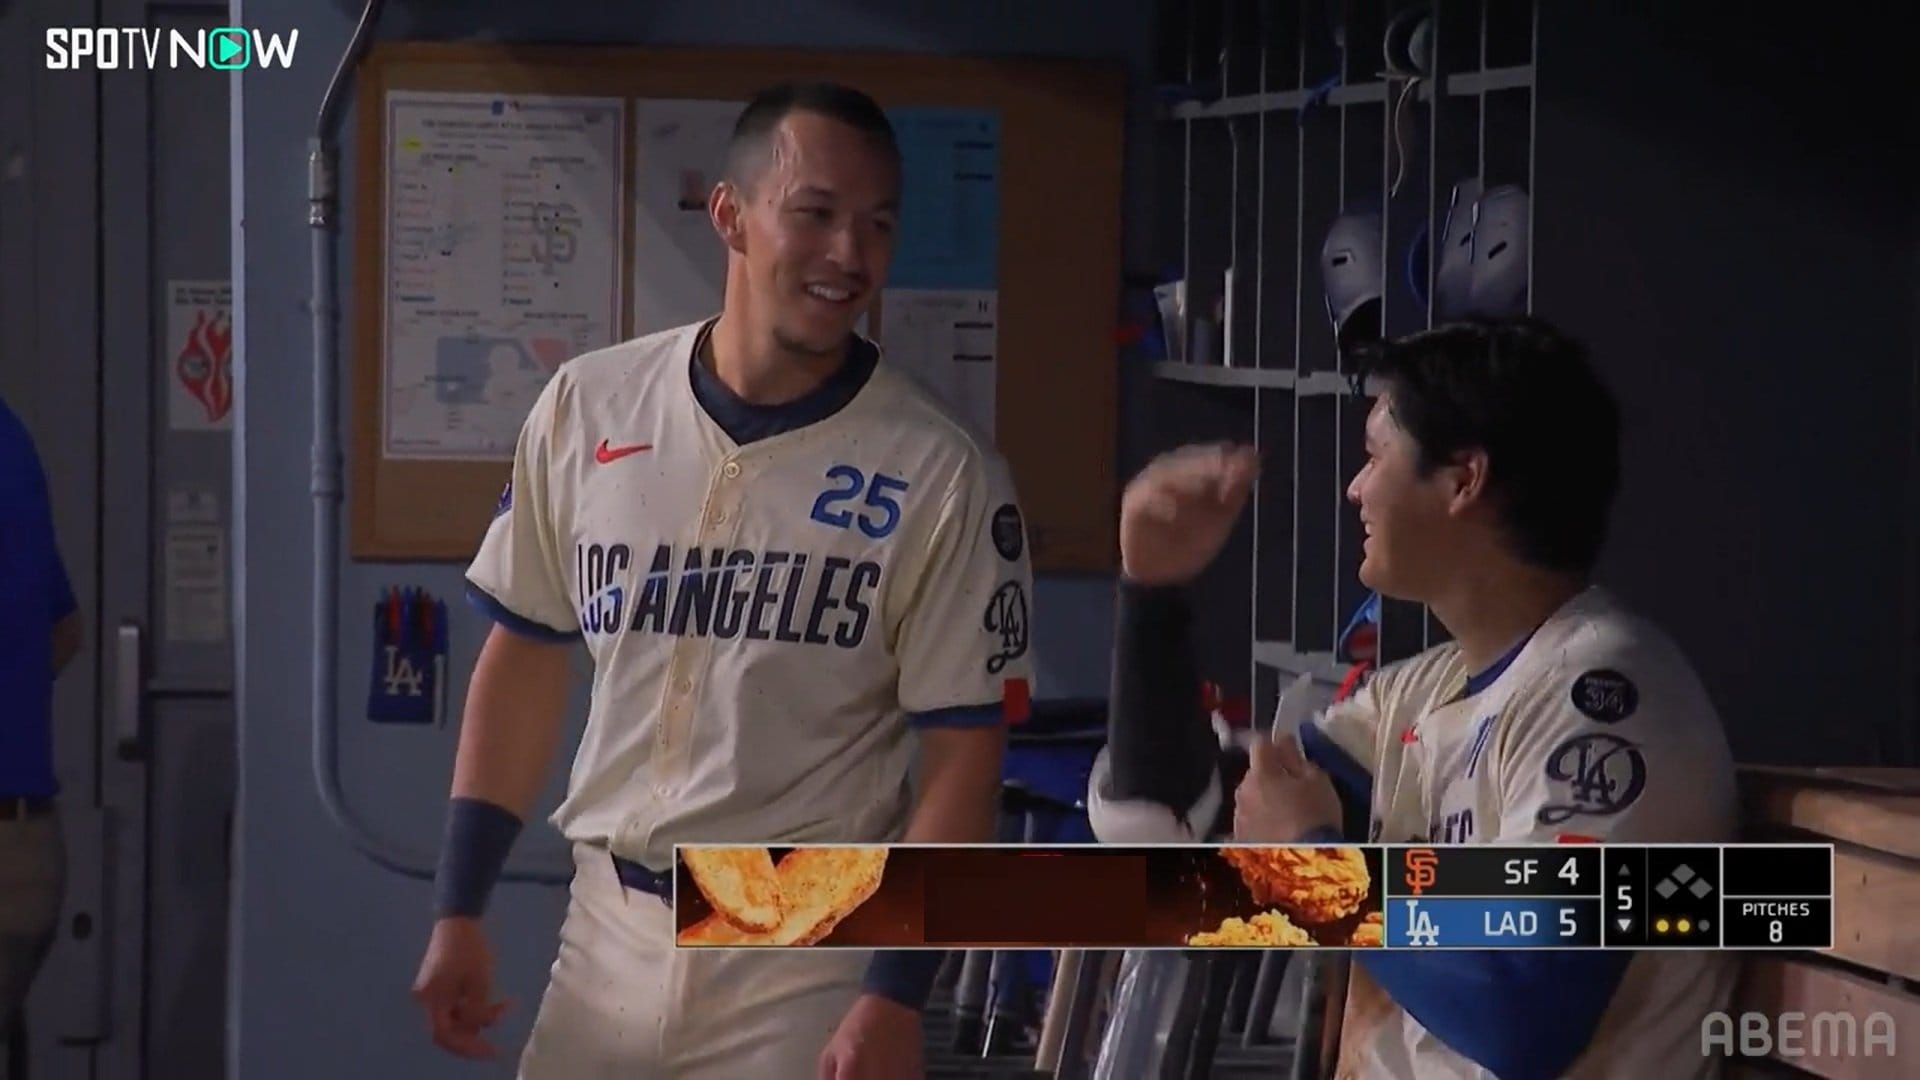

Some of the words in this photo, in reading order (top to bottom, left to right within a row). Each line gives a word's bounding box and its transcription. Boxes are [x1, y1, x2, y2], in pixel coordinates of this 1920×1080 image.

[809, 464, 910, 540] 25
[576, 542, 631, 636] LOS
[631, 543, 882, 649] ANGELES
[383, 645, 424, 697] LA
